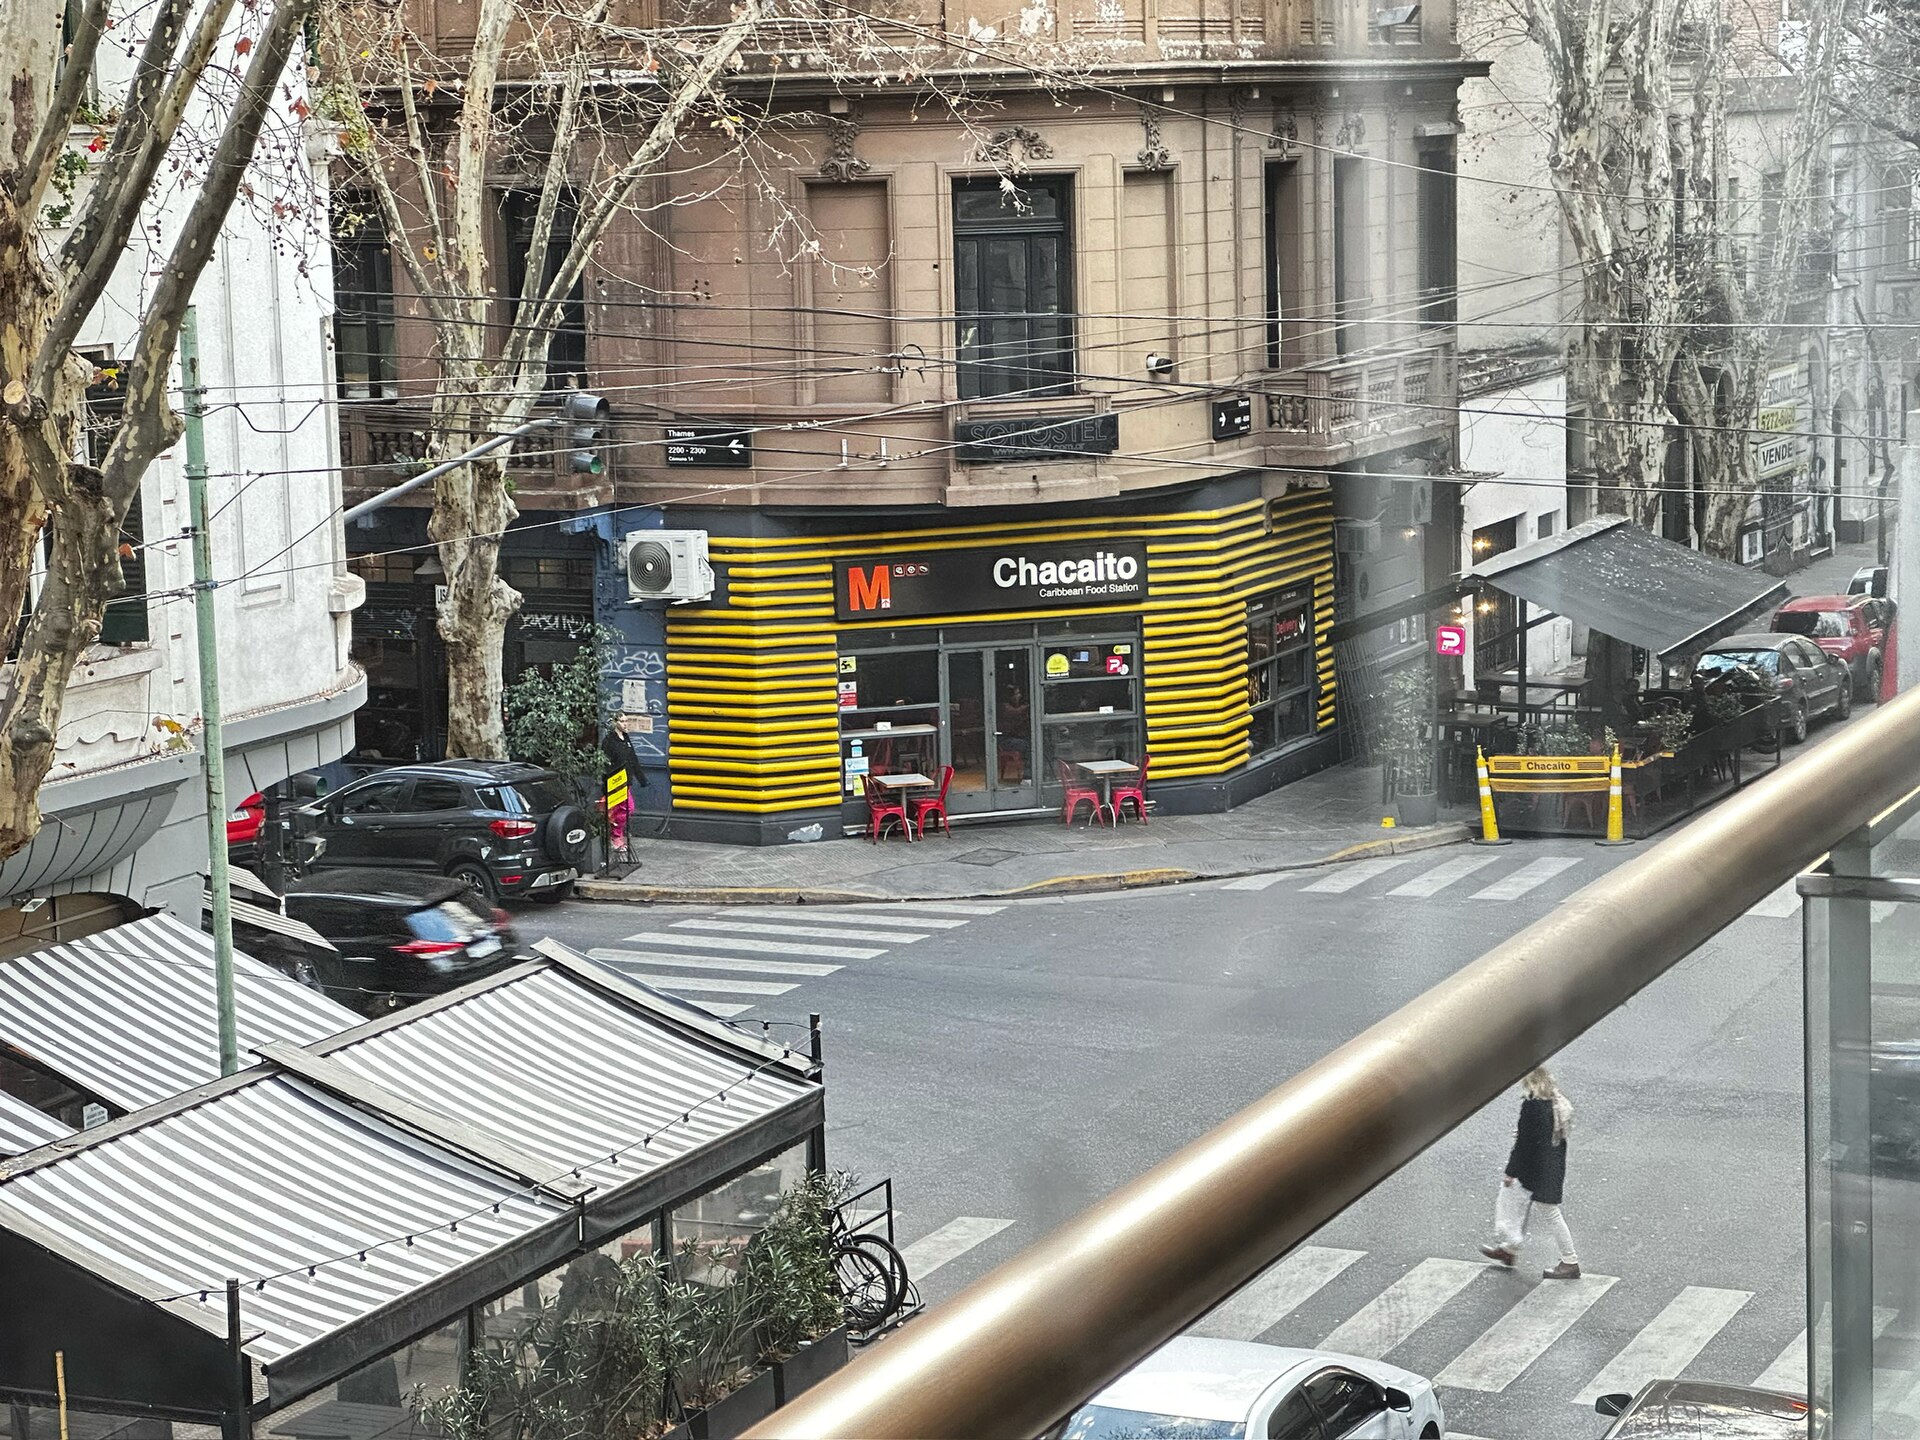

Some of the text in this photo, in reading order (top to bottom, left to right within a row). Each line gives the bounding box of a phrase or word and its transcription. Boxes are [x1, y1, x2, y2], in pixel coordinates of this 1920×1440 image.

[1762, 442, 1793, 467] VENDE
[993, 551, 1138, 588] Chacaito
[1039, 583, 1139, 598] Caribbean Food Station
[1526, 761, 1571, 771] Chacaito
